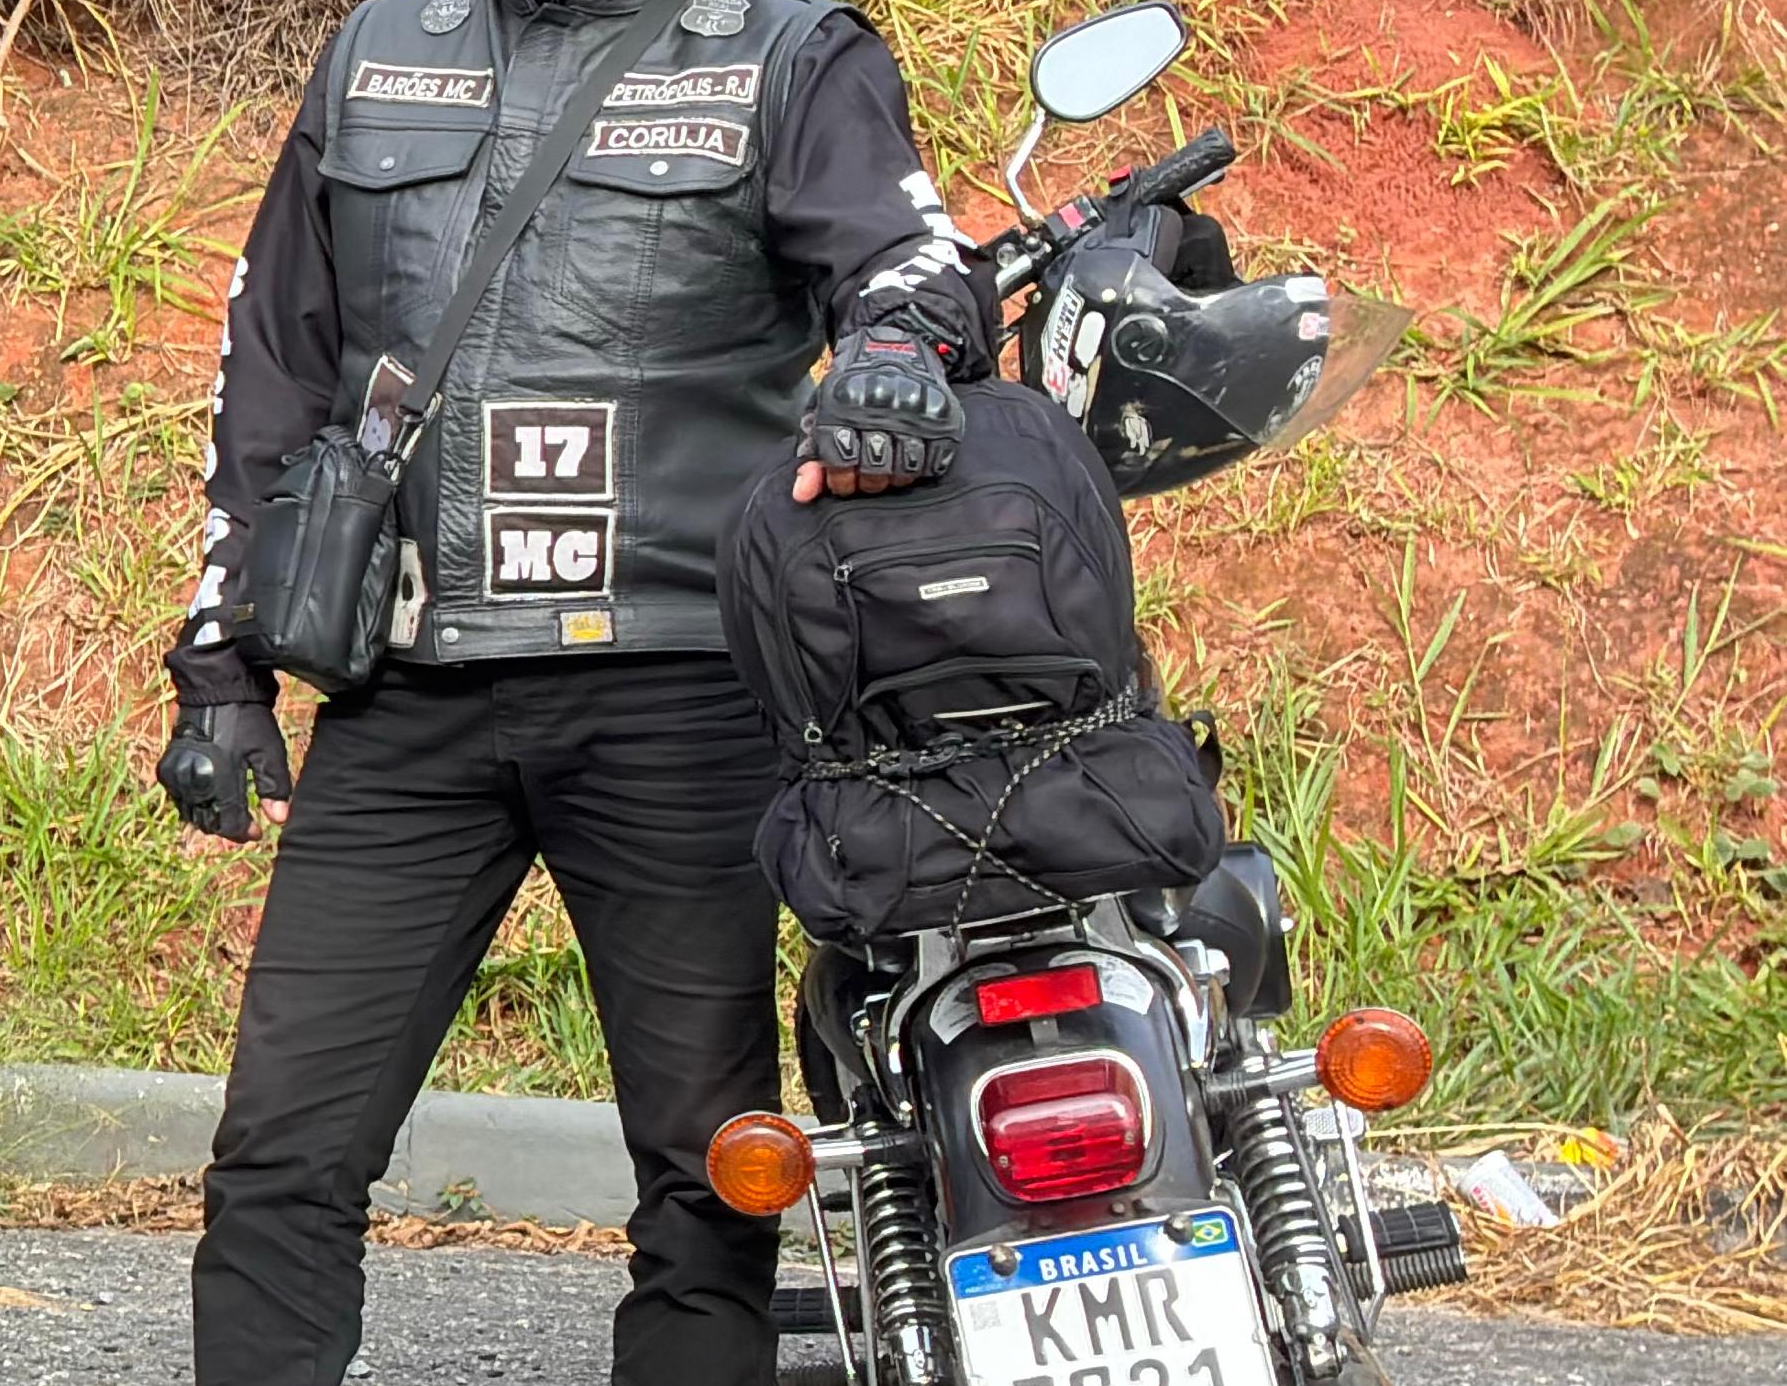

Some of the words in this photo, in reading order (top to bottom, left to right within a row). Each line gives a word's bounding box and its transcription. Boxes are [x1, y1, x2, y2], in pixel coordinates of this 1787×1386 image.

[367, 72, 442, 97] BARÕES
[442, 78, 476, 99] MC
[608, 126, 725, 152] CORUJA
[514, 426, 590, 478] 17
[500, 530, 598, 581] MC
[1039, 1243, 1148, 1281] BRASIL
[1021, 1268, 1194, 1366] KMR
